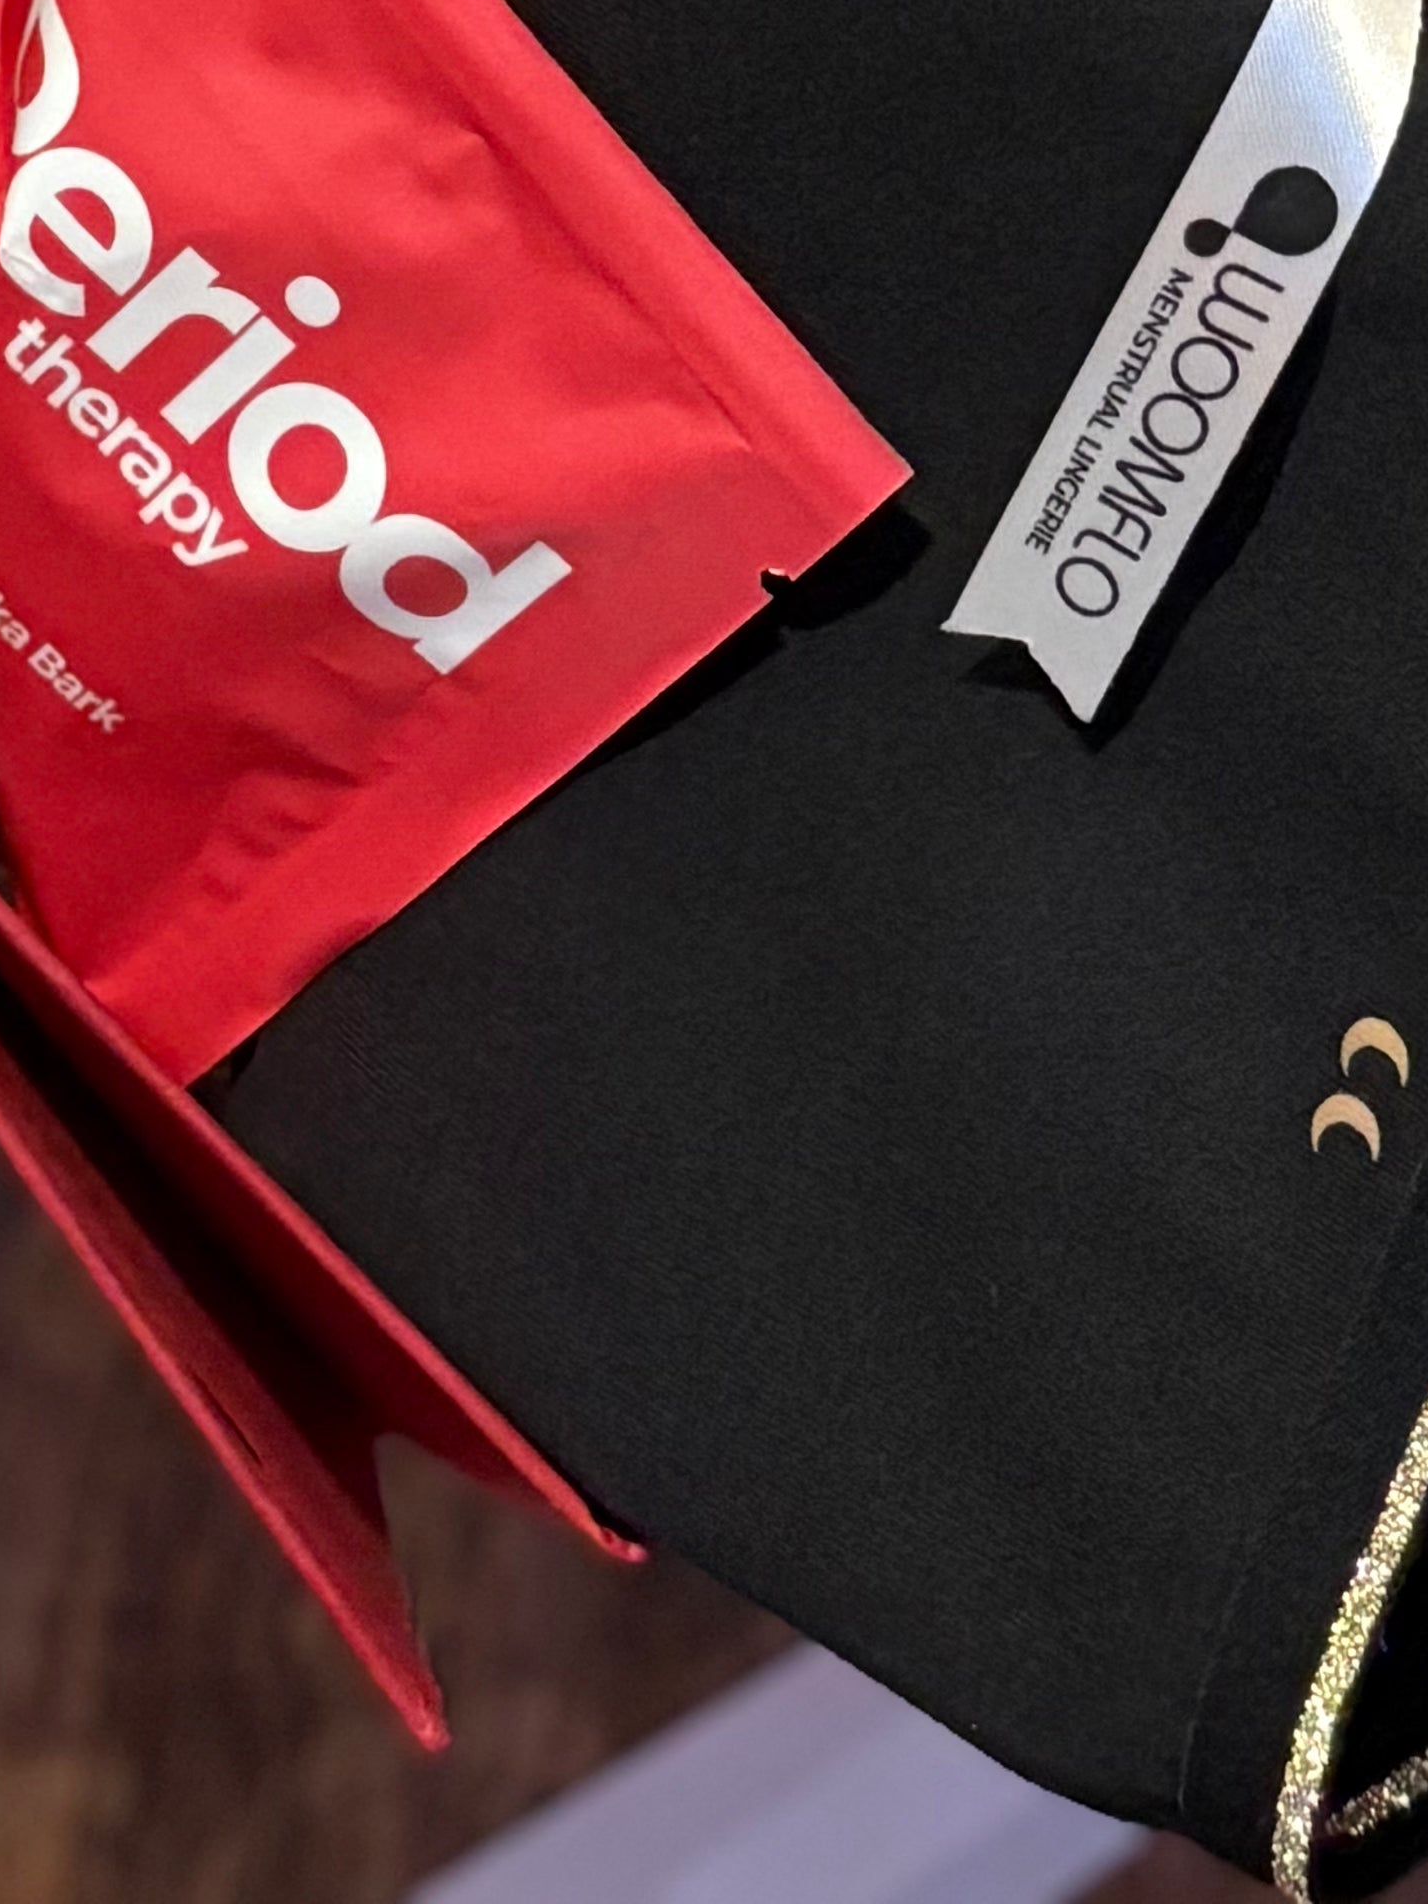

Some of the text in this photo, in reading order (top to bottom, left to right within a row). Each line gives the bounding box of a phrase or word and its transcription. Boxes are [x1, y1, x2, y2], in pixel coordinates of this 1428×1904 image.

[0, 316, 250, 568] therapy
[1024, 267, 1195, 555] MENSTRUAL LINGERIE
[1054, 262, 1285, 618] WOOMFLO
[27, 642, 127, 735] Bark
